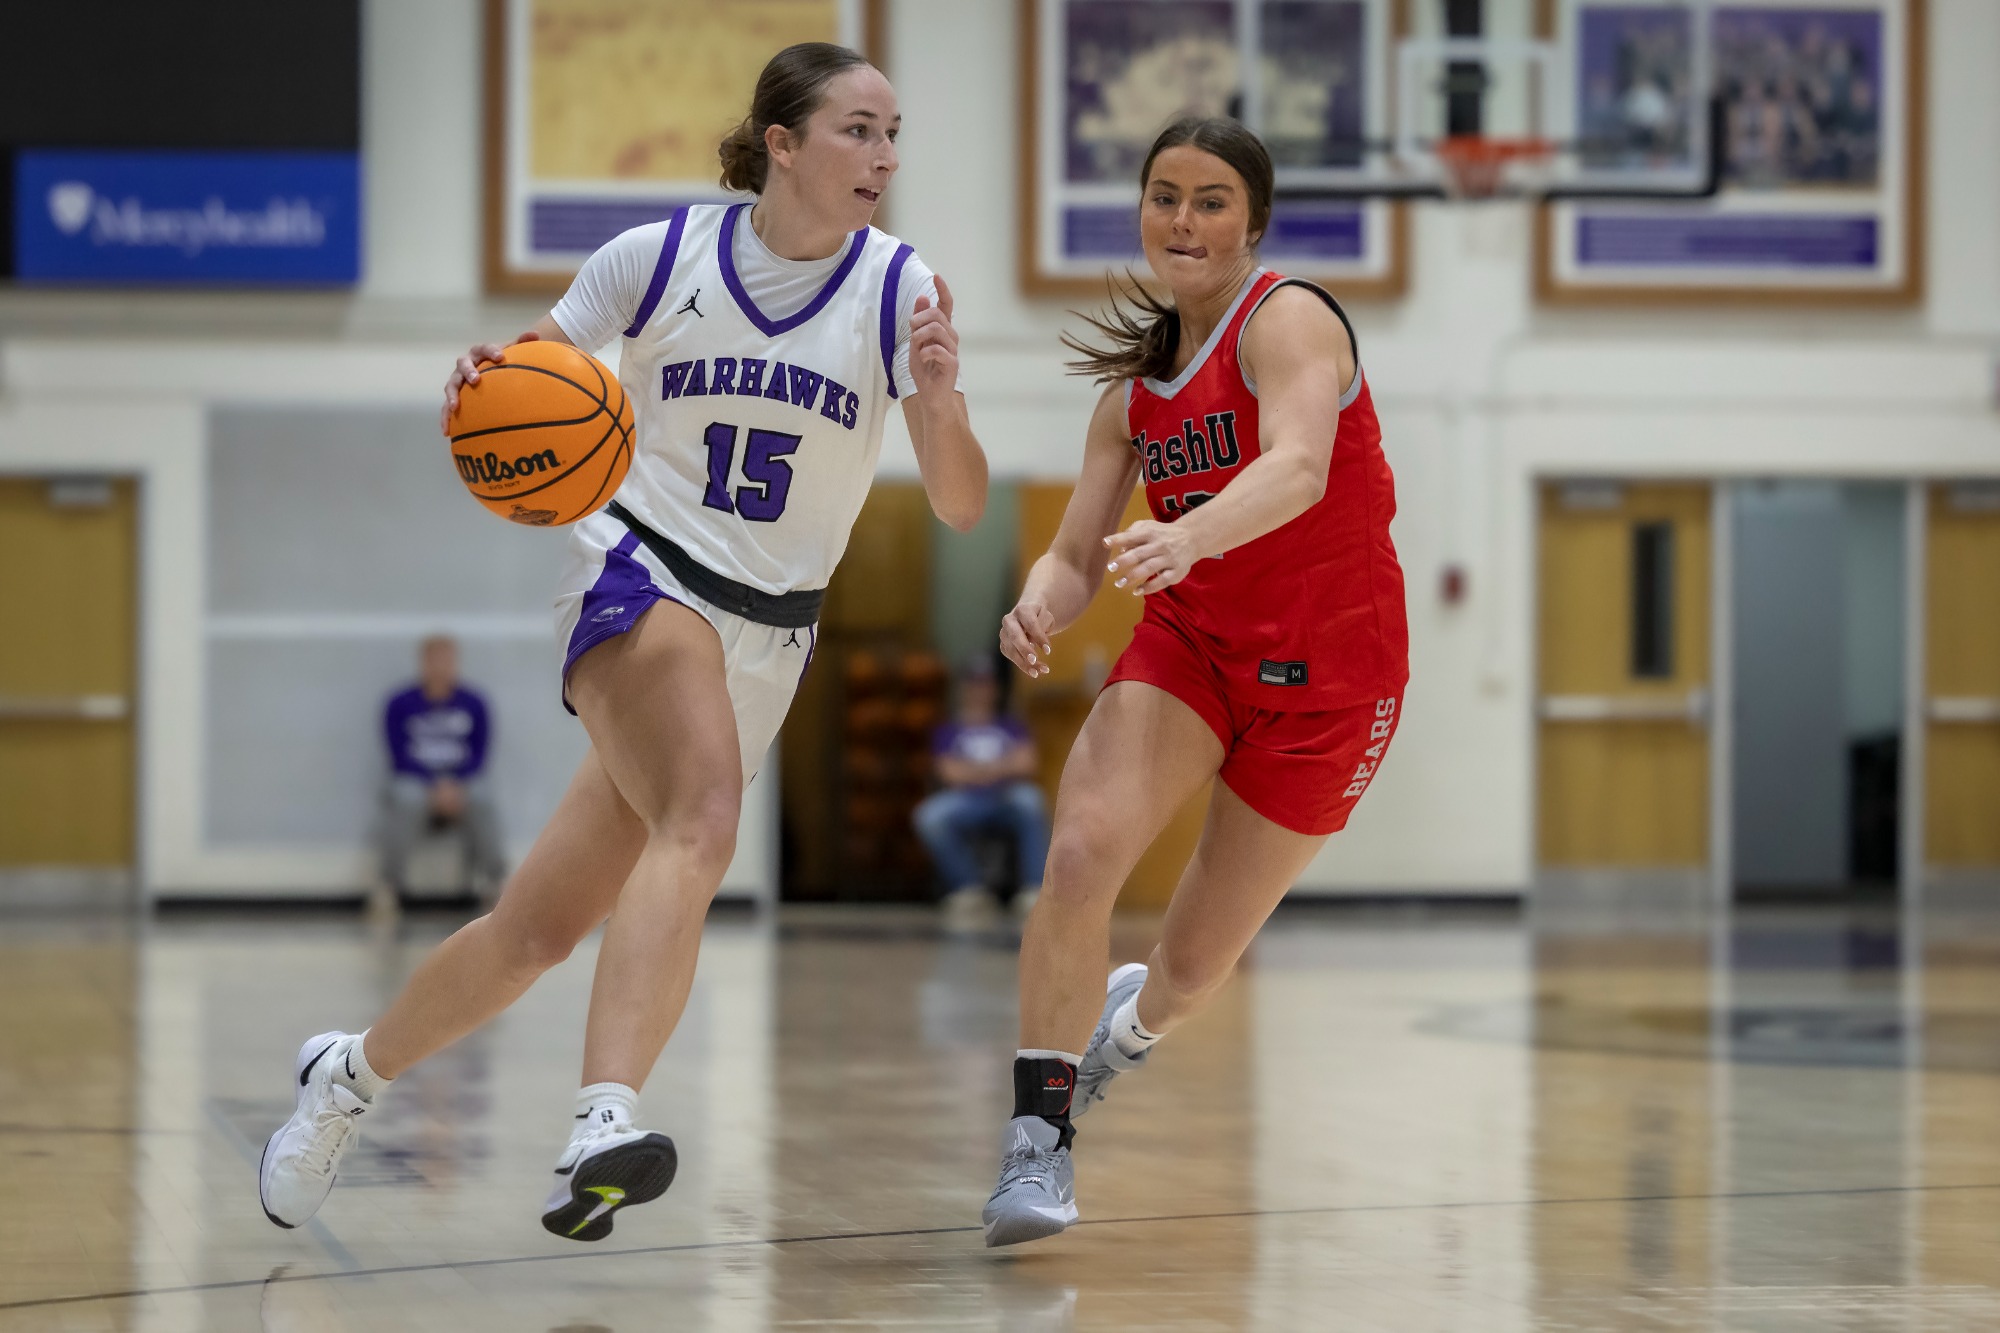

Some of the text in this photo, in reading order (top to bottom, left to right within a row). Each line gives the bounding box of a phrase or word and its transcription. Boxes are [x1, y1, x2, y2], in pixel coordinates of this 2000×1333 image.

[662, 357, 859, 430] WARHAWKS
[455, 448, 561, 484] Wilson
[702, 421, 803, 522] 15
[1291, 668, 1301, 679] M
[1342, 697, 1396, 798] BEARS
